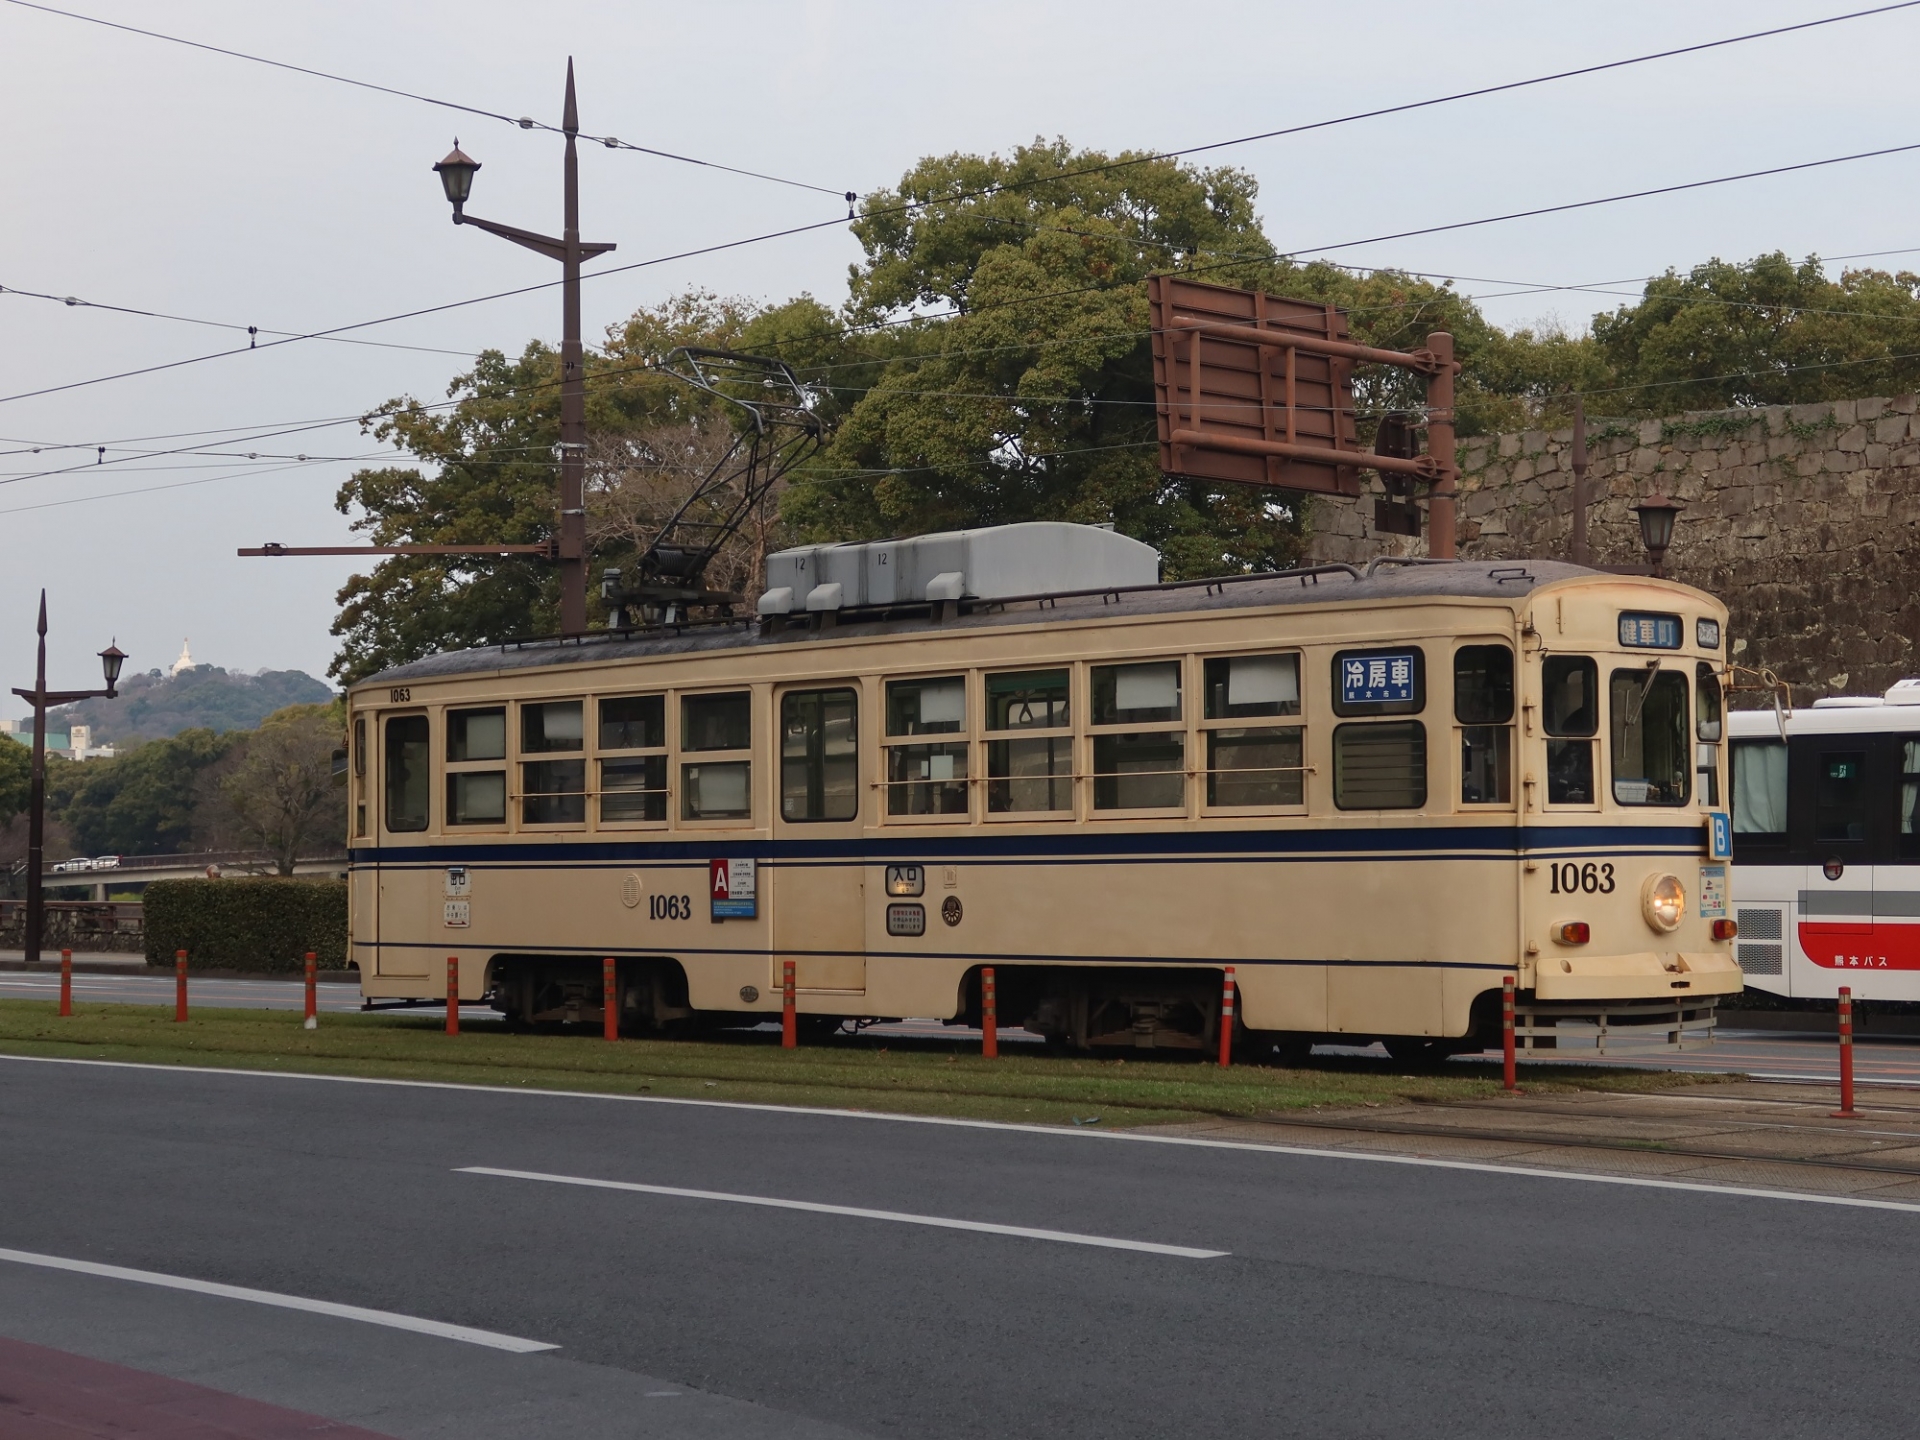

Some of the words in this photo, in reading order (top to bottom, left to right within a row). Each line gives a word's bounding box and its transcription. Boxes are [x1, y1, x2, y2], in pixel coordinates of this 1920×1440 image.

[795, 557, 805, 570] 12
[878, 553, 887, 565] 12
[1621, 619, 1673, 646] 健軍町
[1346, 659, 1409, 688] 冷房車
[390, 688, 411, 703] 1063
[1348, 689, 1408, 700] 熊本市営
[1715, 819, 1726, 852] B
[450, 872, 466, 886] 出口
[714, 867, 728, 892] A
[893, 867, 917, 882] 入口
[1550, 863, 1616, 895] 1063
[649, 895, 692, 921] 1063
[1834, 955, 1888, 967] 熊本バス
